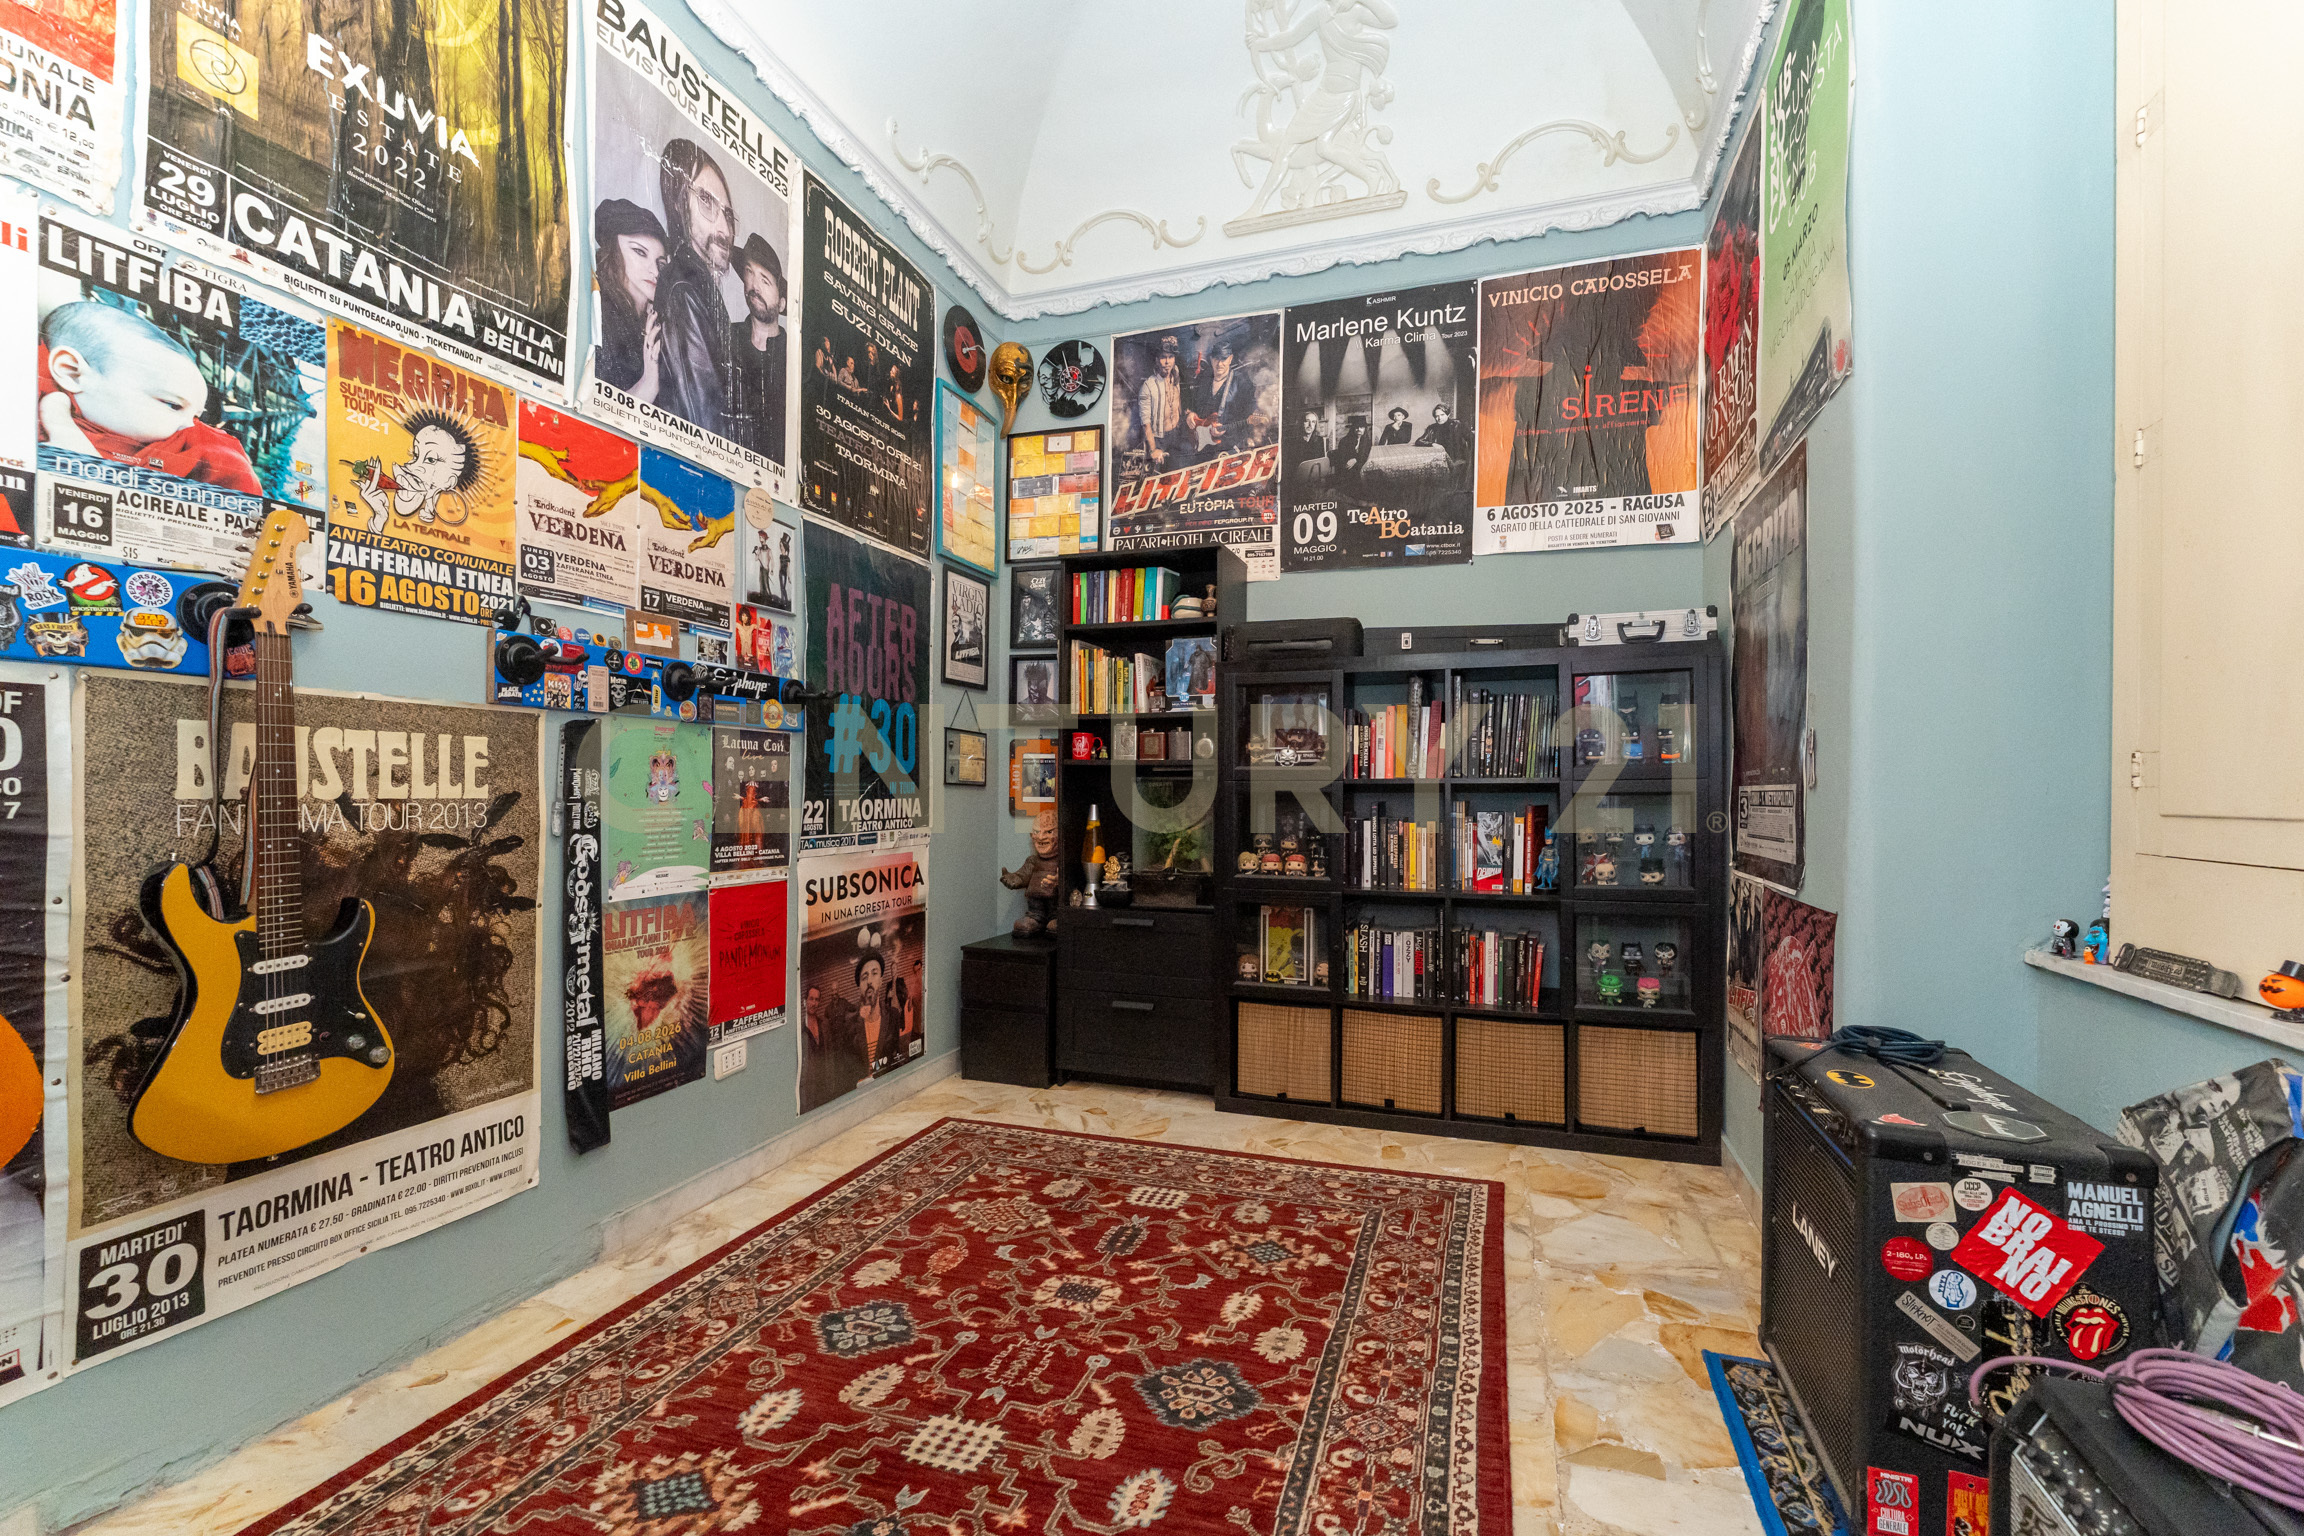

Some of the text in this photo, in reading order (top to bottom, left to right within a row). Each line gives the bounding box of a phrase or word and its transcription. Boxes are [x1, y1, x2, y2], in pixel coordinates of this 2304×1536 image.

[597, 0, 788, 184] BAUSTELLE
[597, 21, 788, 197] ELVIS TOUR ESTATE 2023
[162, 150, 212, 178] VENERDÌ
[353, 133, 426, 189] 2022
[157, 161, 216, 206] 29
[151, 191, 220, 224] LUGLIO
[48, 225, 233, 328] LITFIBA
[202, 267, 247, 293] TIGRA
[234, 193, 553, 353] CATANIA VILLA
[824, 205, 920, 332] ROBERT PLANT
[1488, 265, 1692, 307] VINICIO CAPOSSELA
[824, 271, 918, 352] SAVING GRACE
[1366, 296, 1397, 306] KASHMIR
[284, 273, 482, 366] BIGLIETTI SU PUNTOEACAPO.UNO TICKETTANDO.IT
[1296, 303, 1466, 342] Marlene Kuntz
[483, 327, 563, 376] BELLINI
[1365, 335, 1400, 348] Karma
[1405, 331, 1436, 343] Clima
[337, 325, 508, 428] NEGRITA
[339, 382, 406, 412] SUMMER
[342, 394, 375, 417] TOUR
[346, 408, 389, 435] 2021
[594, 397, 743, 469] BIGLIETTI SU PUNTOEACAPO.UNO
[595, 382, 635, 409] 19.08
[640, 403, 703, 441] CATANIA
[706, 432, 742, 457] VILLA
[745, 450, 786, 479] BELLINI
[835, 443, 908, 490] TAORMINA
[56, 456, 263, 515] mondi sommersi
[58, 487, 109, 503] VENERDI'
[62, 502, 103, 528] 16
[116, 491, 207, 522] ACIREALE
[1180, 495, 1276, 514] EUTÒPIA TOUR
[1487, 494, 1685, 521] 6 AGOSTO 2025 RAGUSA
[58, 527, 109, 541] MAGGIO
[528, 510, 627, 551] VERDENA
[1293, 511, 1338, 545] 09
[1491, 511, 1680, 534] SAGRATO DELLA CATTEDRALE DI SAN GIOVANNI
[329, 525, 514, 576] ANFITEATRO COMUNALE
[1293, 544, 1337, 554] MAGGIO
[1737, 488, 1800, 596] NEGRITA
[288, 561, 297, 590] YAMAHA
[328, 540, 451, 585] ZAFFERANA
[456, 570, 514, 597] ETNEA
[525, 553, 550, 571] 03
[556, 552, 606, 572] VERDENA
[556, 563, 594, 576] ZAFFERANA
[648, 553, 726, 587] VERDENA
[328, 567, 376, 606] 16
[380, 575, 479, 615] AGOSTO
[523, 572, 553, 582] AGOSTO
[952, 580, 984, 602] VIRGIN
[644, 594, 660, 607] 17
[952, 594, 985, 616] RADIO
[134, 618, 168, 627] WARS
[139, 613, 167, 621] STAR
[955, 649, 980, 660] LITFIBA
[824, 694, 916, 774] #30
[803, 800, 824, 824] 22
[839, 799, 921, 821] TAORMINA
[803, 822, 823, 831] AGOSTO
[851, 818, 913, 832] TEATRO ANTICO
[806, 864, 924, 906] SUBSONICA
[605, 903, 697, 940] LITFIBA
[821, 895, 912, 923] IN UNA FORESTA TOUR
[1360, 924, 1369, 953] SLASH
[565, 1001, 575, 1032] 2012
[732, 1007, 779, 1027] ZAFFERANA
[620, 1022, 682, 1050] 04.08.2026
[710, 1028, 719, 1037] 12
[581, 1038, 592, 1078] RHO
[591, 1029, 602, 1081] MILANO
[628, 1042, 674, 1064] CATANIA
[624, 1058, 677, 1083] Villa Bellini
[218, 1115, 523, 1241] TAORMINA TEATRO ANTICO
[1964, 1181, 1981, 1190] CCCP
[218, 1245, 255, 1267] PLATEA
[257, 1226, 308, 1253] NUMERATA
[310, 1222, 317, 1232] €
[319, 1213, 343, 1230] 27.50
[351, 1193, 396, 1218] GRADINATA
[404, 1182, 427, 1198] 22.00
[433, 1171, 458, 1187] DIRITTI
[460, 1157, 500, 1180] PREVENDITA
[501, 1147, 524, 1162] INCLUSI
[2067, 1181, 2144, 1206] MANUEL
[2000, 1196, 2053, 1241] NO
[2068, 1200, 2144, 1224] AGNELLI
[2094, 1221, 2128, 1230] PROSSIMO
[101, 1221, 187, 1266] MARTEDI'
[1792, 1204, 1838, 1278] LANEY
[2067, 1224, 2086, 1232] COME
[2099, 1228, 2125, 1237] STESSO
[85, 1243, 198, 1319] 30
[93, 1292, 190, 1340] LUGLIO 2013
[121, 1316, 165, 1340] ORE 21.30
[1943, 1402, 1977, 1427] FUCK
[1900, 1417, 1985, 1460] NUX
[1878, 1519, 1908, 1534] GENERALE
[1880, 1507, 1905, 1521] CULTURA
